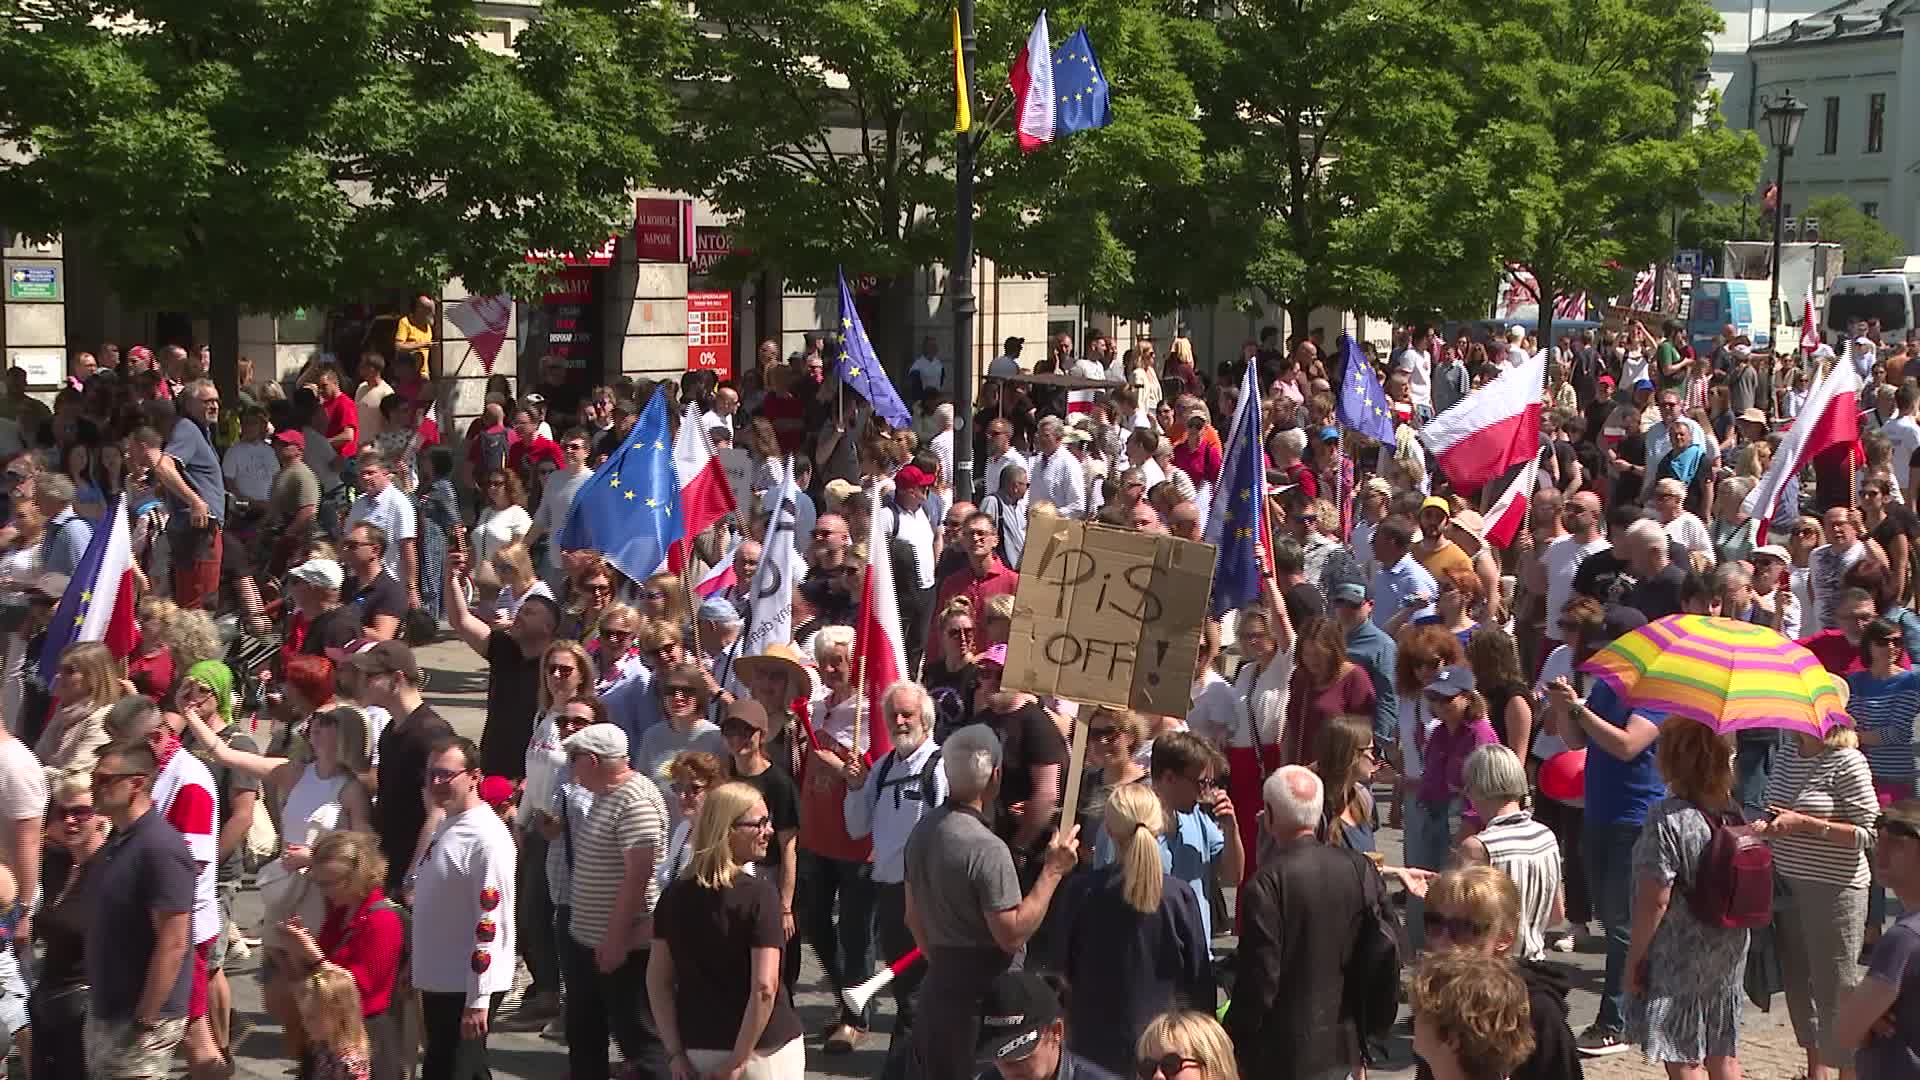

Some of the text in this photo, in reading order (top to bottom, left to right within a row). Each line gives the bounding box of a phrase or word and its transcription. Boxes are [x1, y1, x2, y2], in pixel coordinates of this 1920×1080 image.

[638, 215, 677, 226] ALKOHOLE
[643, 232, 672, 245] NAPOJE
[699, 351, 717, 366] 0%
[1048, 549, 1167, 622] PiS
